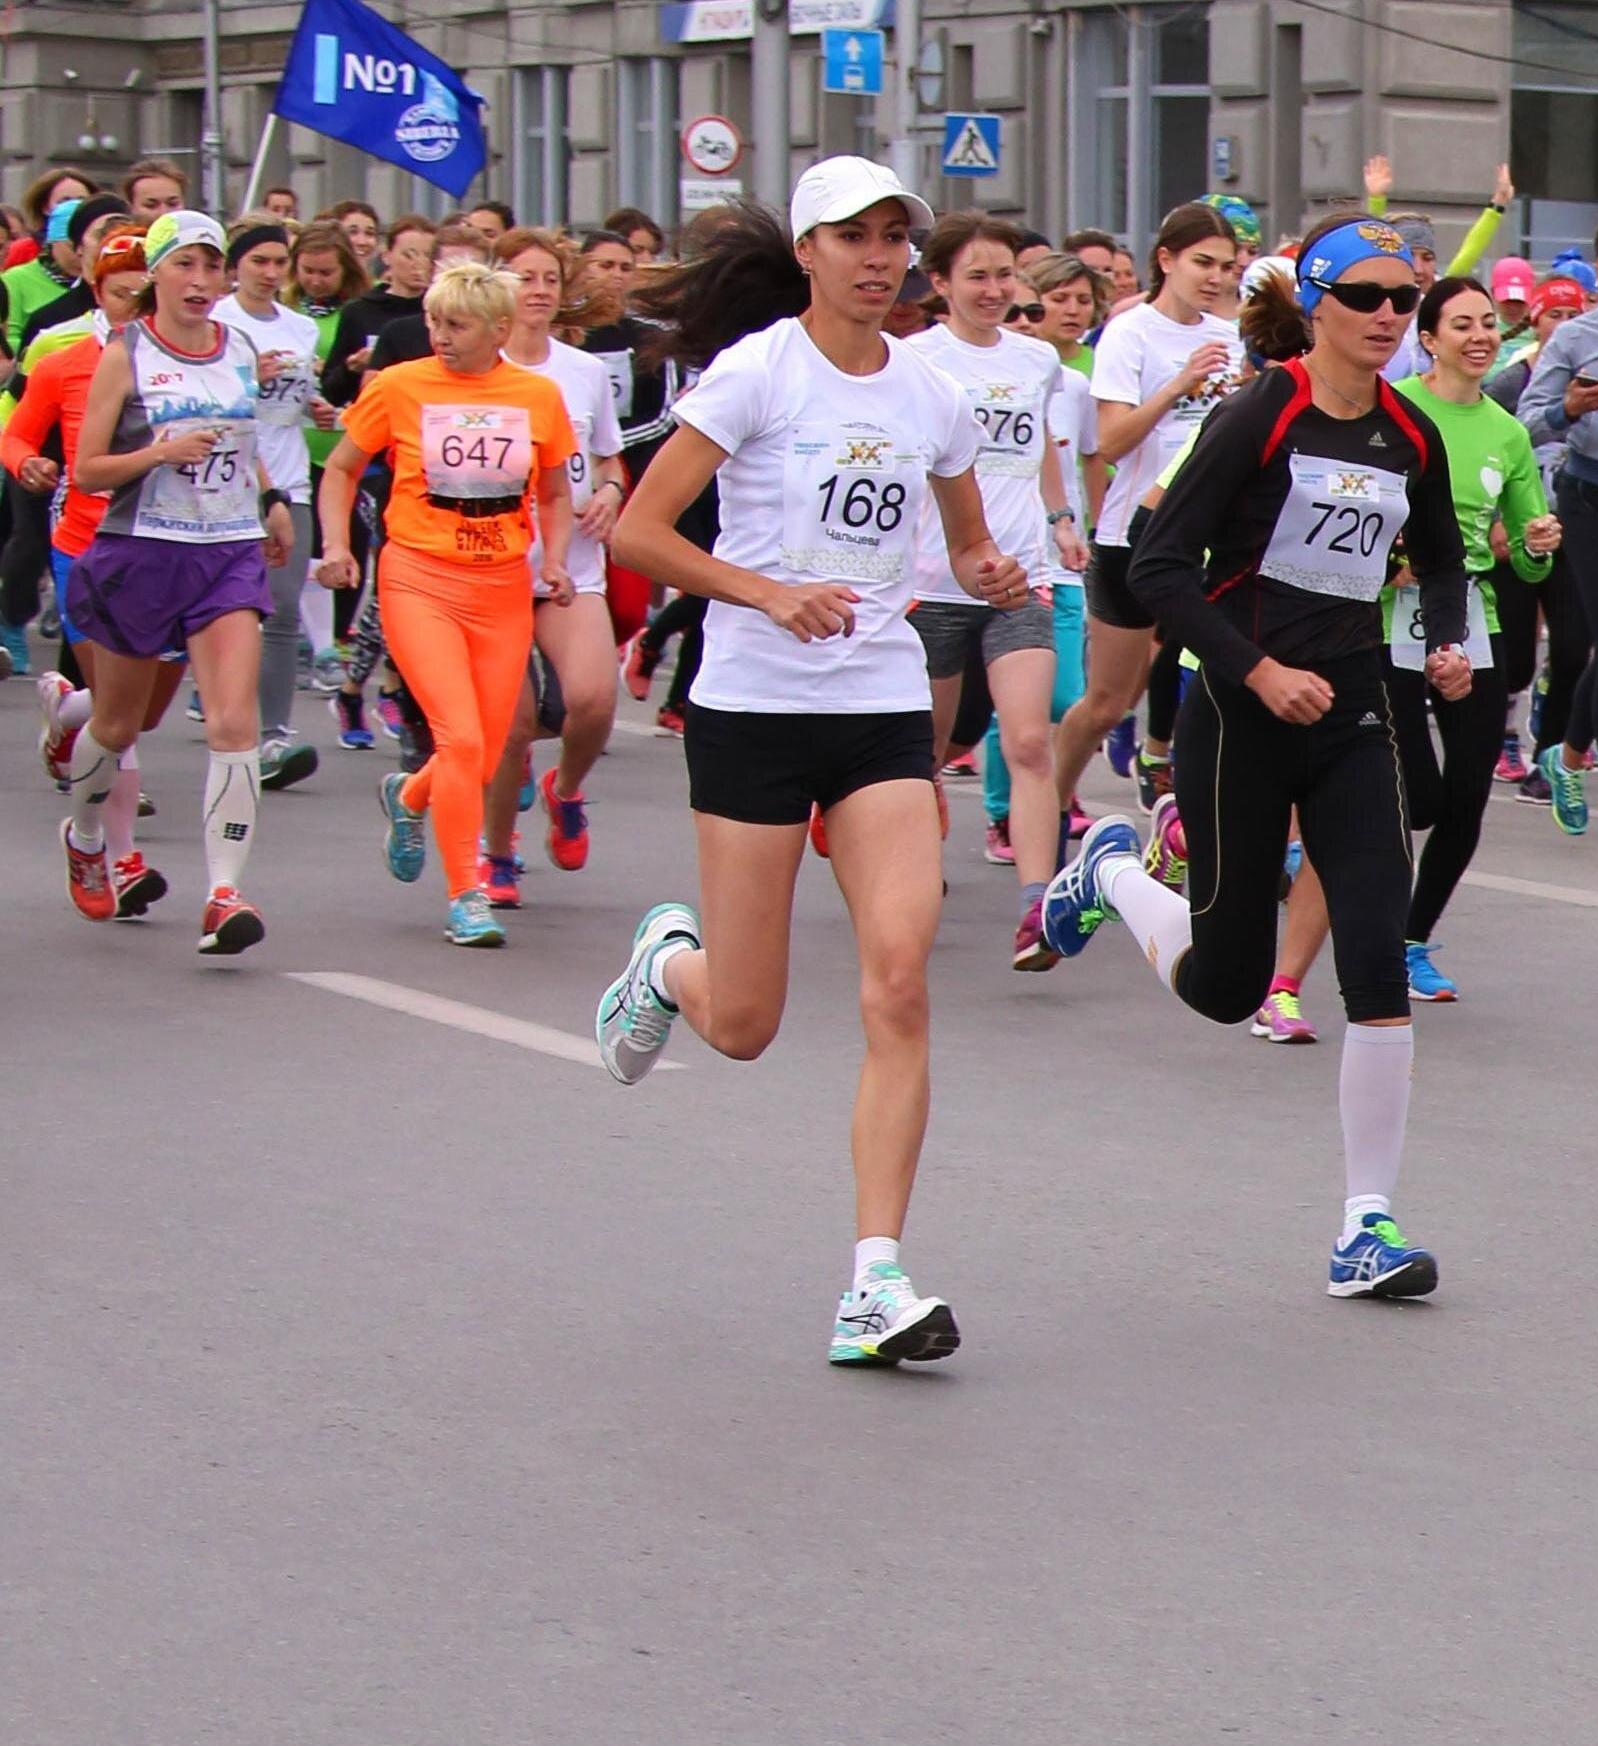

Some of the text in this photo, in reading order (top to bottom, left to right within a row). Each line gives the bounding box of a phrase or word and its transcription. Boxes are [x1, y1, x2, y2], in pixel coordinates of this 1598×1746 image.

[343, 53, 417, 95] №1
[176, 449, 240, 485] 475
[441, 435, 514, 470] 647
[818, 474, 907, 532] 168
[825, 528, 880, 546] Чальцева
[1304, 502, 1384, 558] 720
